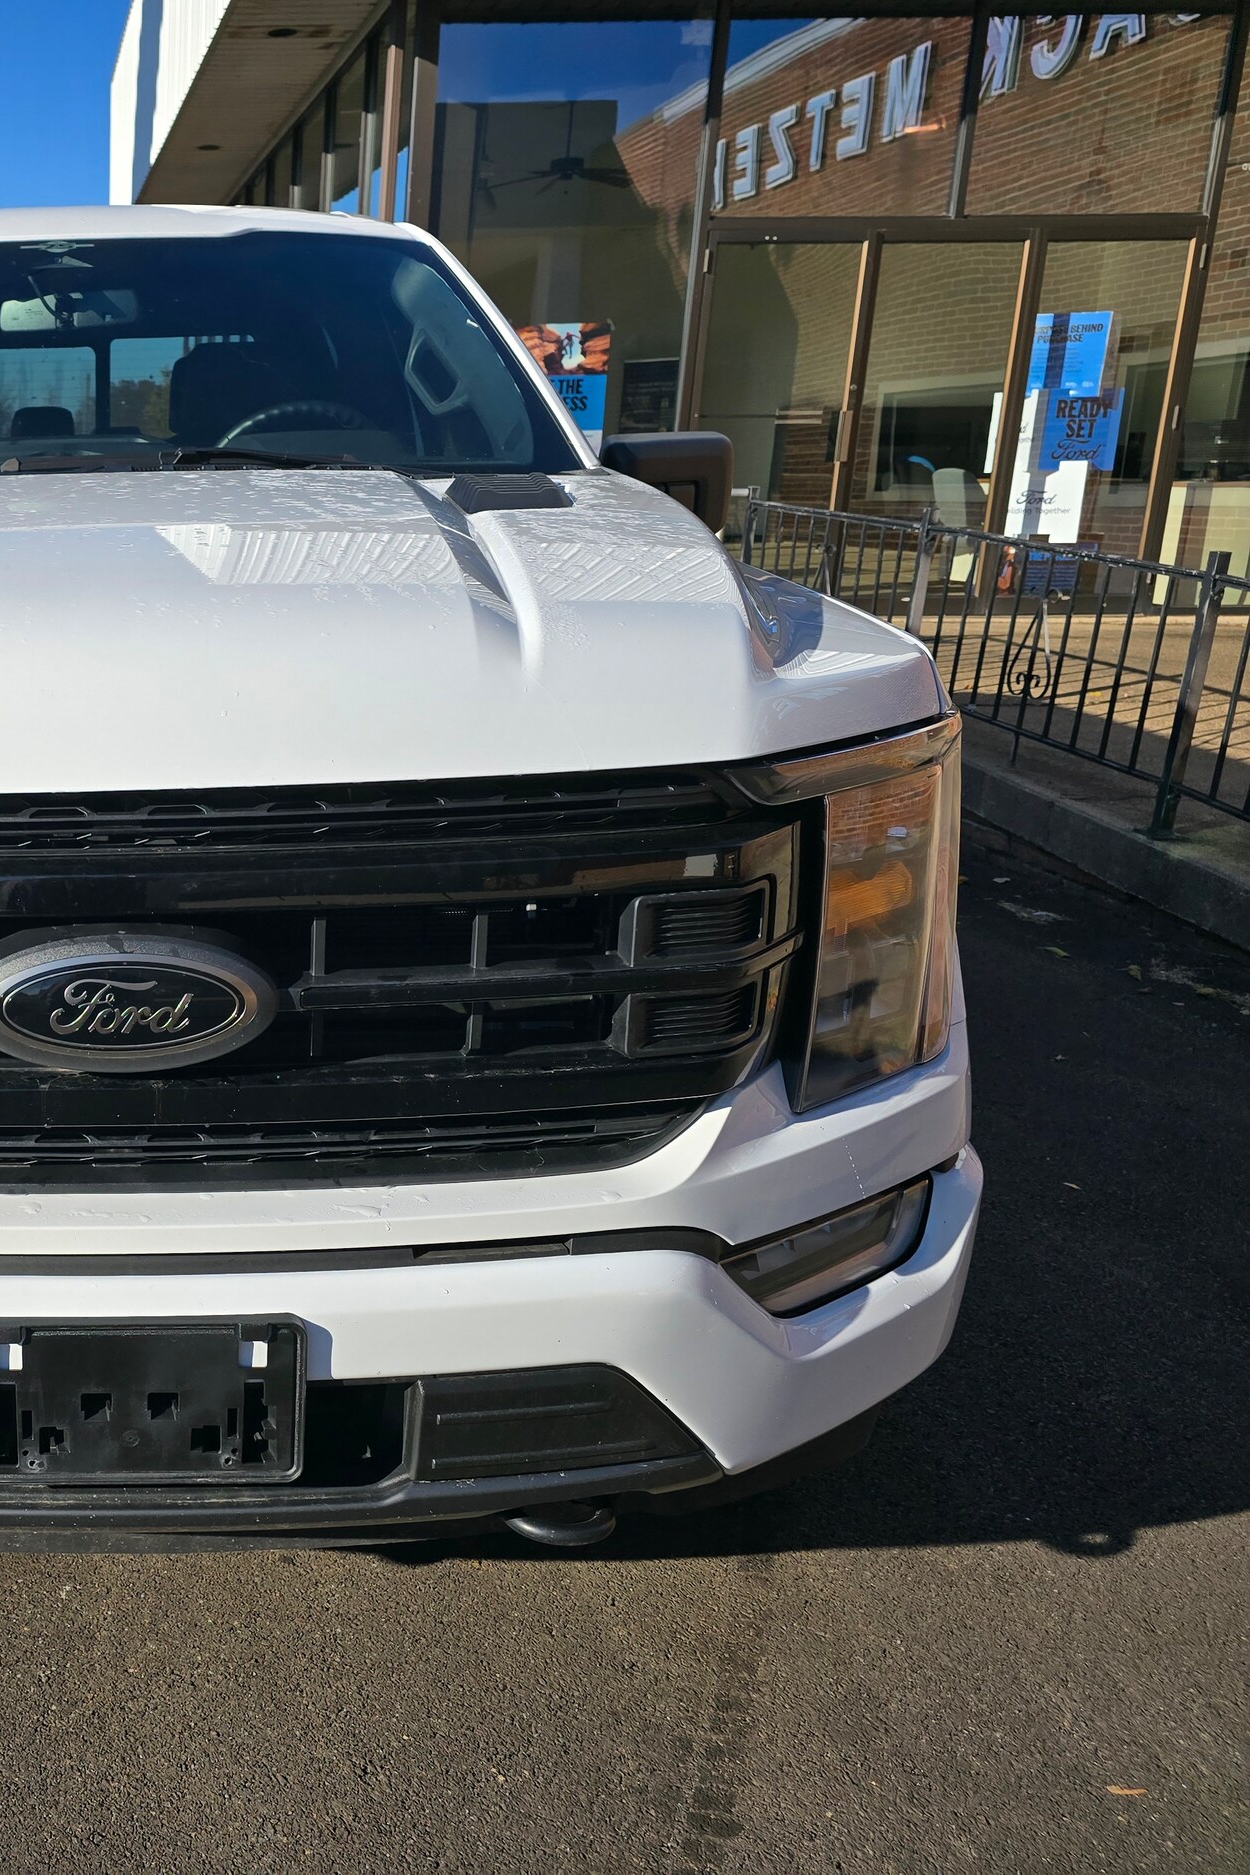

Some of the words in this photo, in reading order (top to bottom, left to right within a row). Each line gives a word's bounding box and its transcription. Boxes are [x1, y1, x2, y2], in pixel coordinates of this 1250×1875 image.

[1070, 323, 1104, 334] BEHIND
[558, 379, 585, 394] THE
[1055, 399, 1111, 418] READY
[1065, 419, 1097, 438] SET
[1050, 438, 1102, 461] Ford
[1016, 489, 1058, 504] Ford
[50, 978, 195, 1035] Ford
